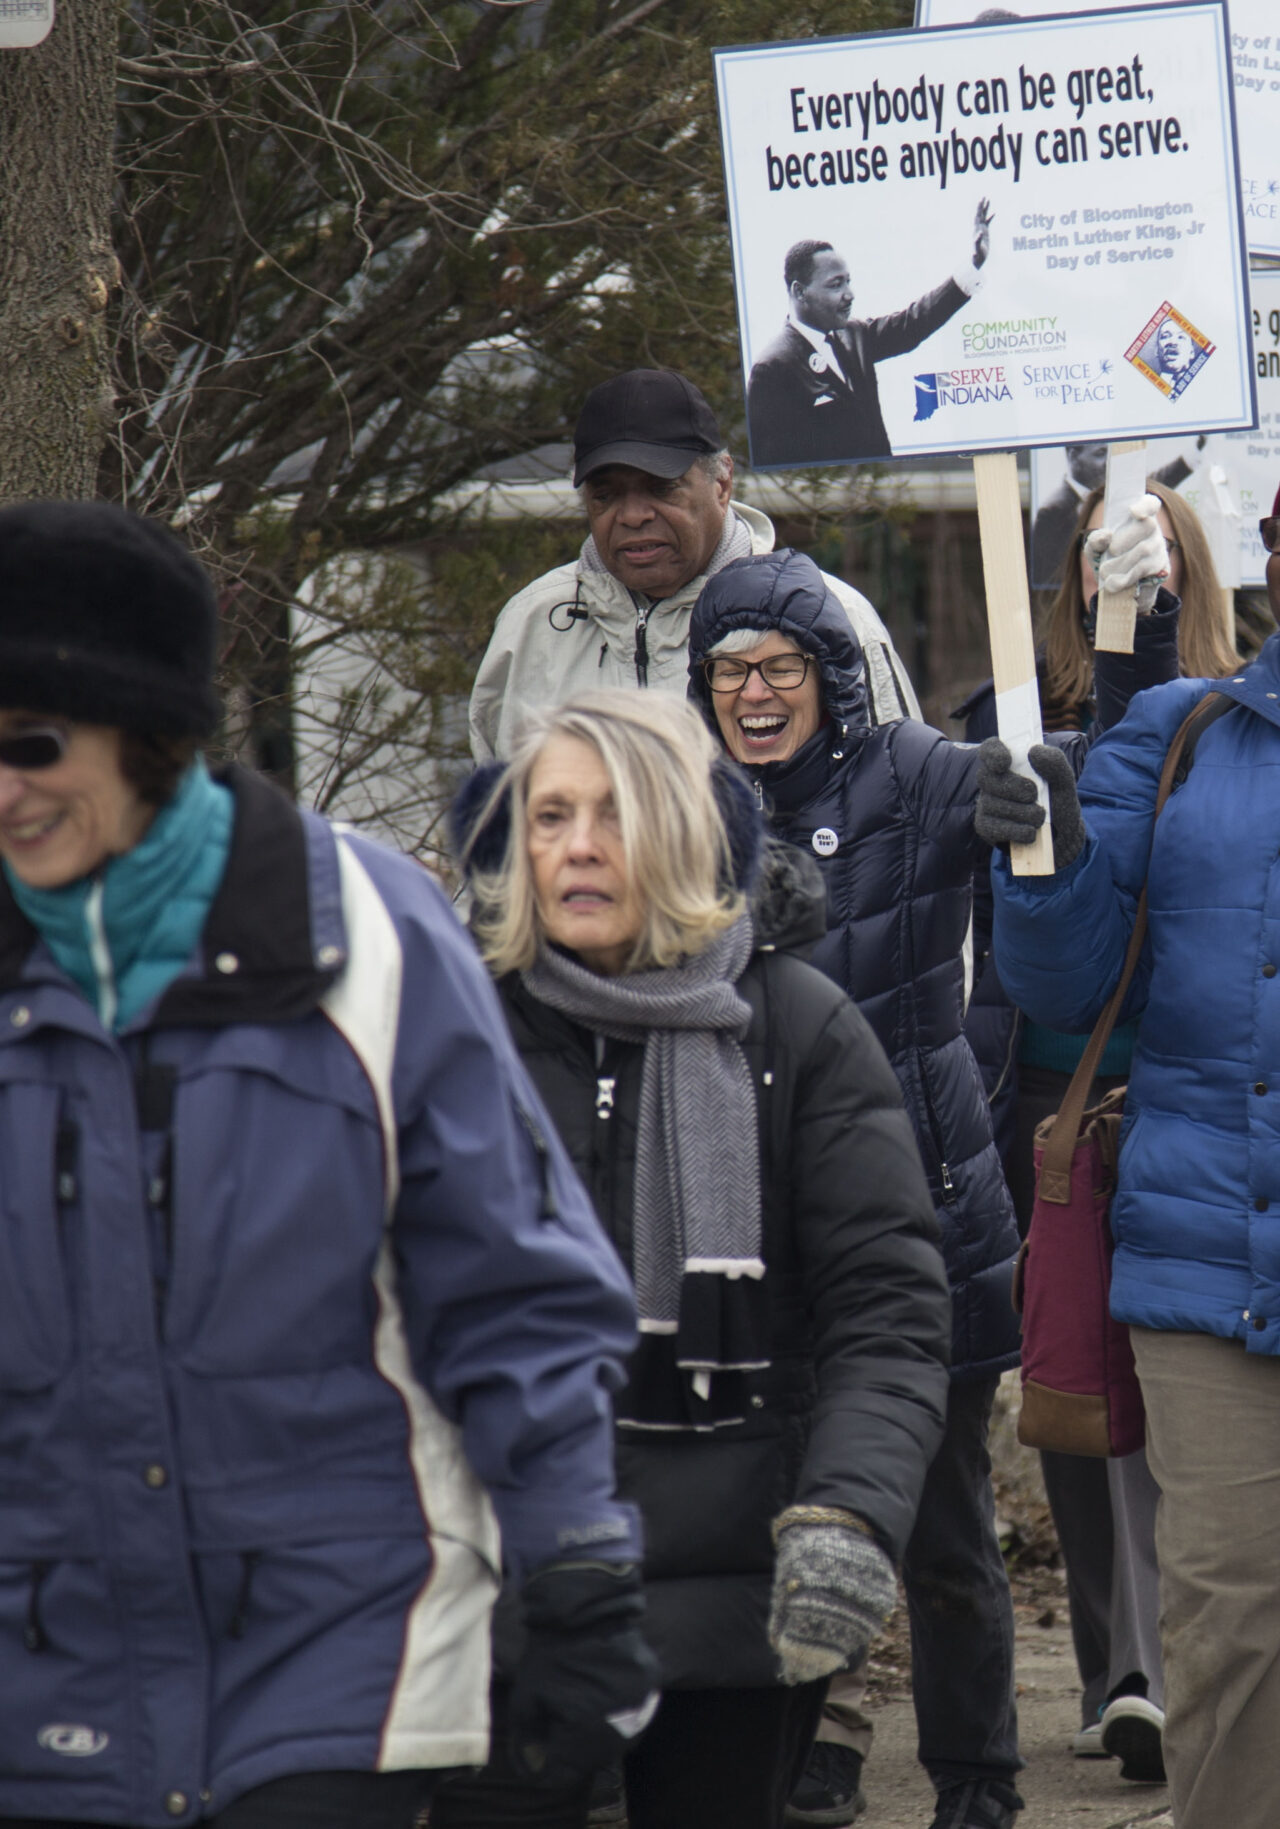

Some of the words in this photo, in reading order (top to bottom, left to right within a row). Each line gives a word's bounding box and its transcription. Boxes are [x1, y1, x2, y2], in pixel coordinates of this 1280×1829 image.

[1231, 33, 1248, 50] ty
[1253, 36, 1271, 49] of
[1234, 73, 1265, 92] Day
[790, 73, 944, 141] Everybody
[956, 77, 1009, 117] can
[1019, 63, 1056, 111] be
[1067, 53, 1154, 121] great,
[766, 144, 888, 191] because
[900, 122, 1022, 190] anybody
[1035, 126, 1088, 166] can
[1098, 116, 1189, 160] serve.
[1020, 213, 1055, 230] City
[1060, 209, 1077, 226] of
[1083, 202, 1193, 223] Bloomington
[1246, 203, 1278, 219] ACE
[1013, 233, 1069, 251] Martin
[1074, 228, 1131, 246] Luther
[1136, 224, 1181, 241] King,
[1186, 220, 1205, 236] Jr
[1046, 254, 1079, 271] Day
[1084, 251, 1101, 266] of
[1107, 246, 1174, 264] Service
[962, 316, 1058, 338] COMMUNITY
[963, 330, 1066, 351] FOUNDATION
[1023, 363, 1090, 386] SERVICE
[1257, 351, 1280, 378] an
[951, 366, 1006, 386] SERVE
[940, 384, 1013, 406] INDIANA
[1035, 385, 1058, 399] FOR
[1061, 384, 1115, 405] PEACE
[1247, 444, 1270, 458] Day
